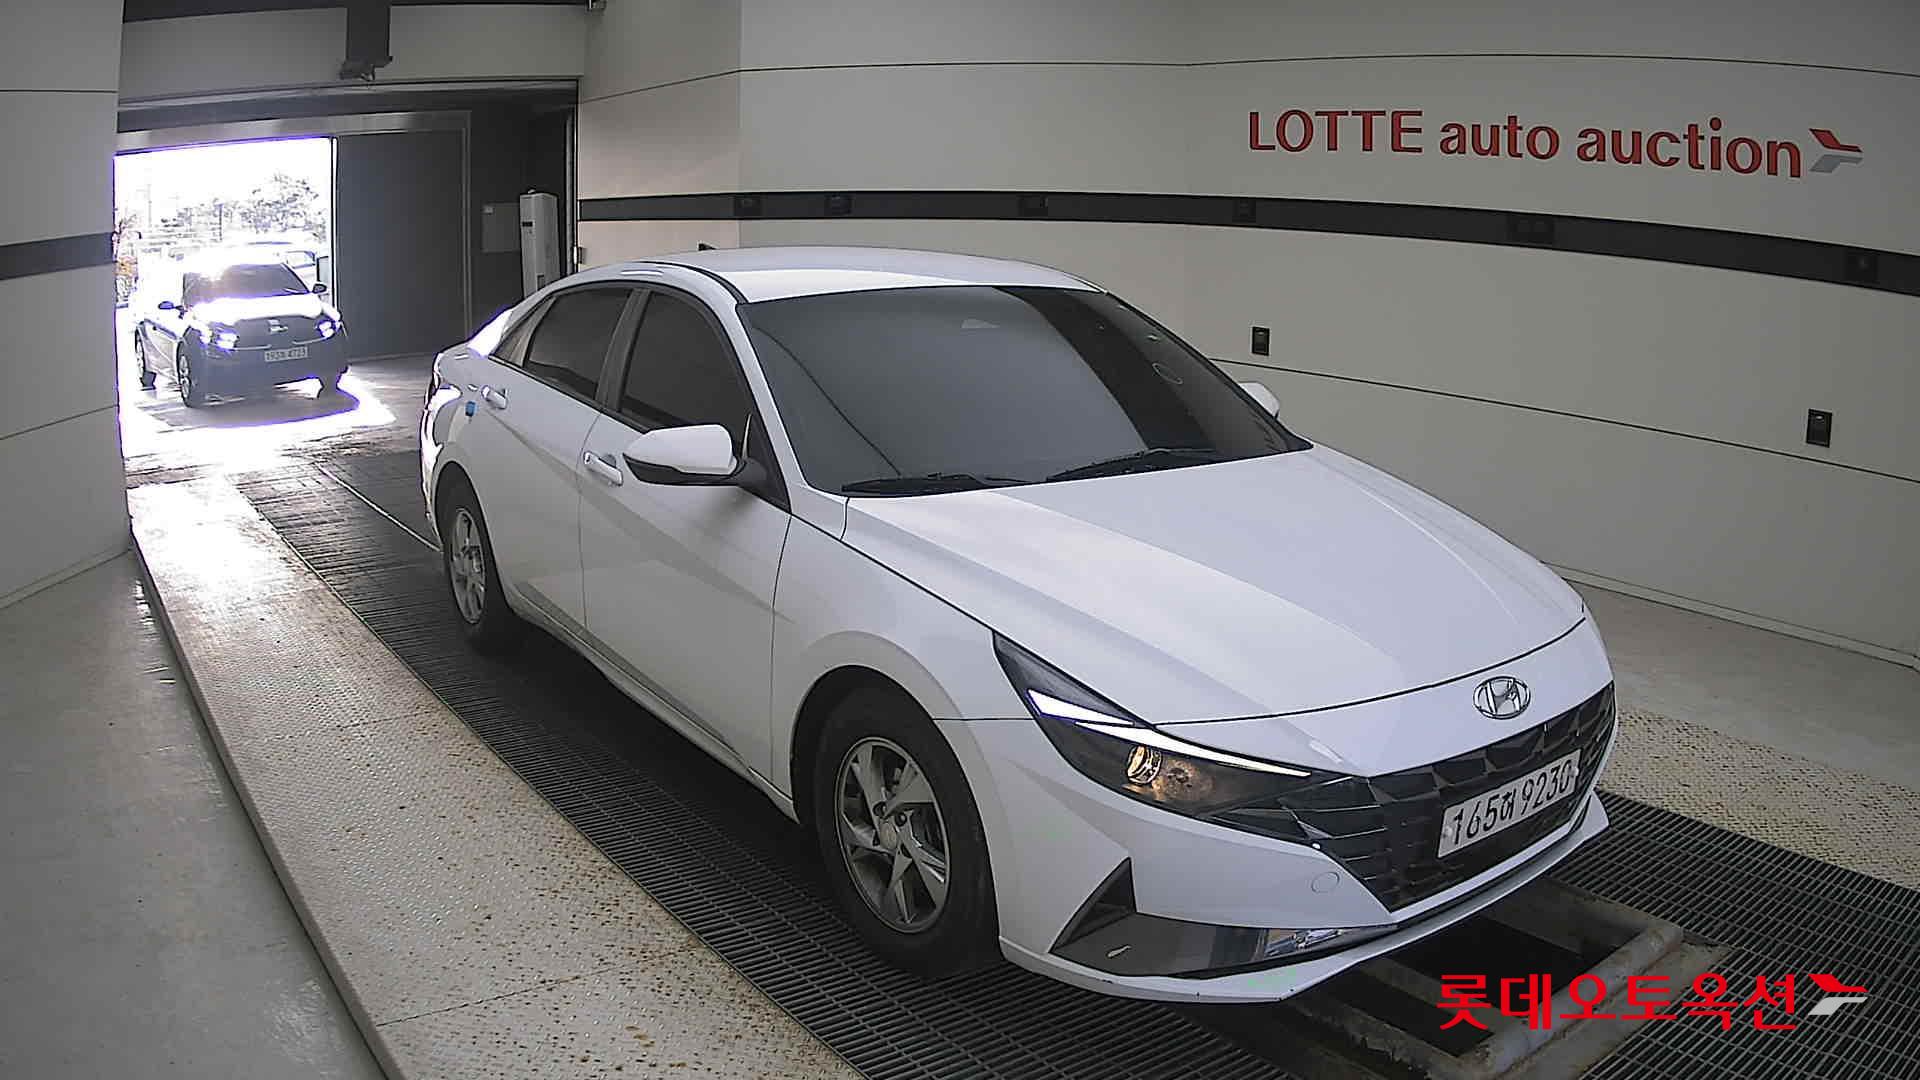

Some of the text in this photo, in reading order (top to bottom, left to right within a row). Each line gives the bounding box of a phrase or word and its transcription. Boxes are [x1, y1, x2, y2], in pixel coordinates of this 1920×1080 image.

[1248, 109, 1802, 179] LOTTE auto auction
[1453, 759, 1572, 845] 165허 9230
